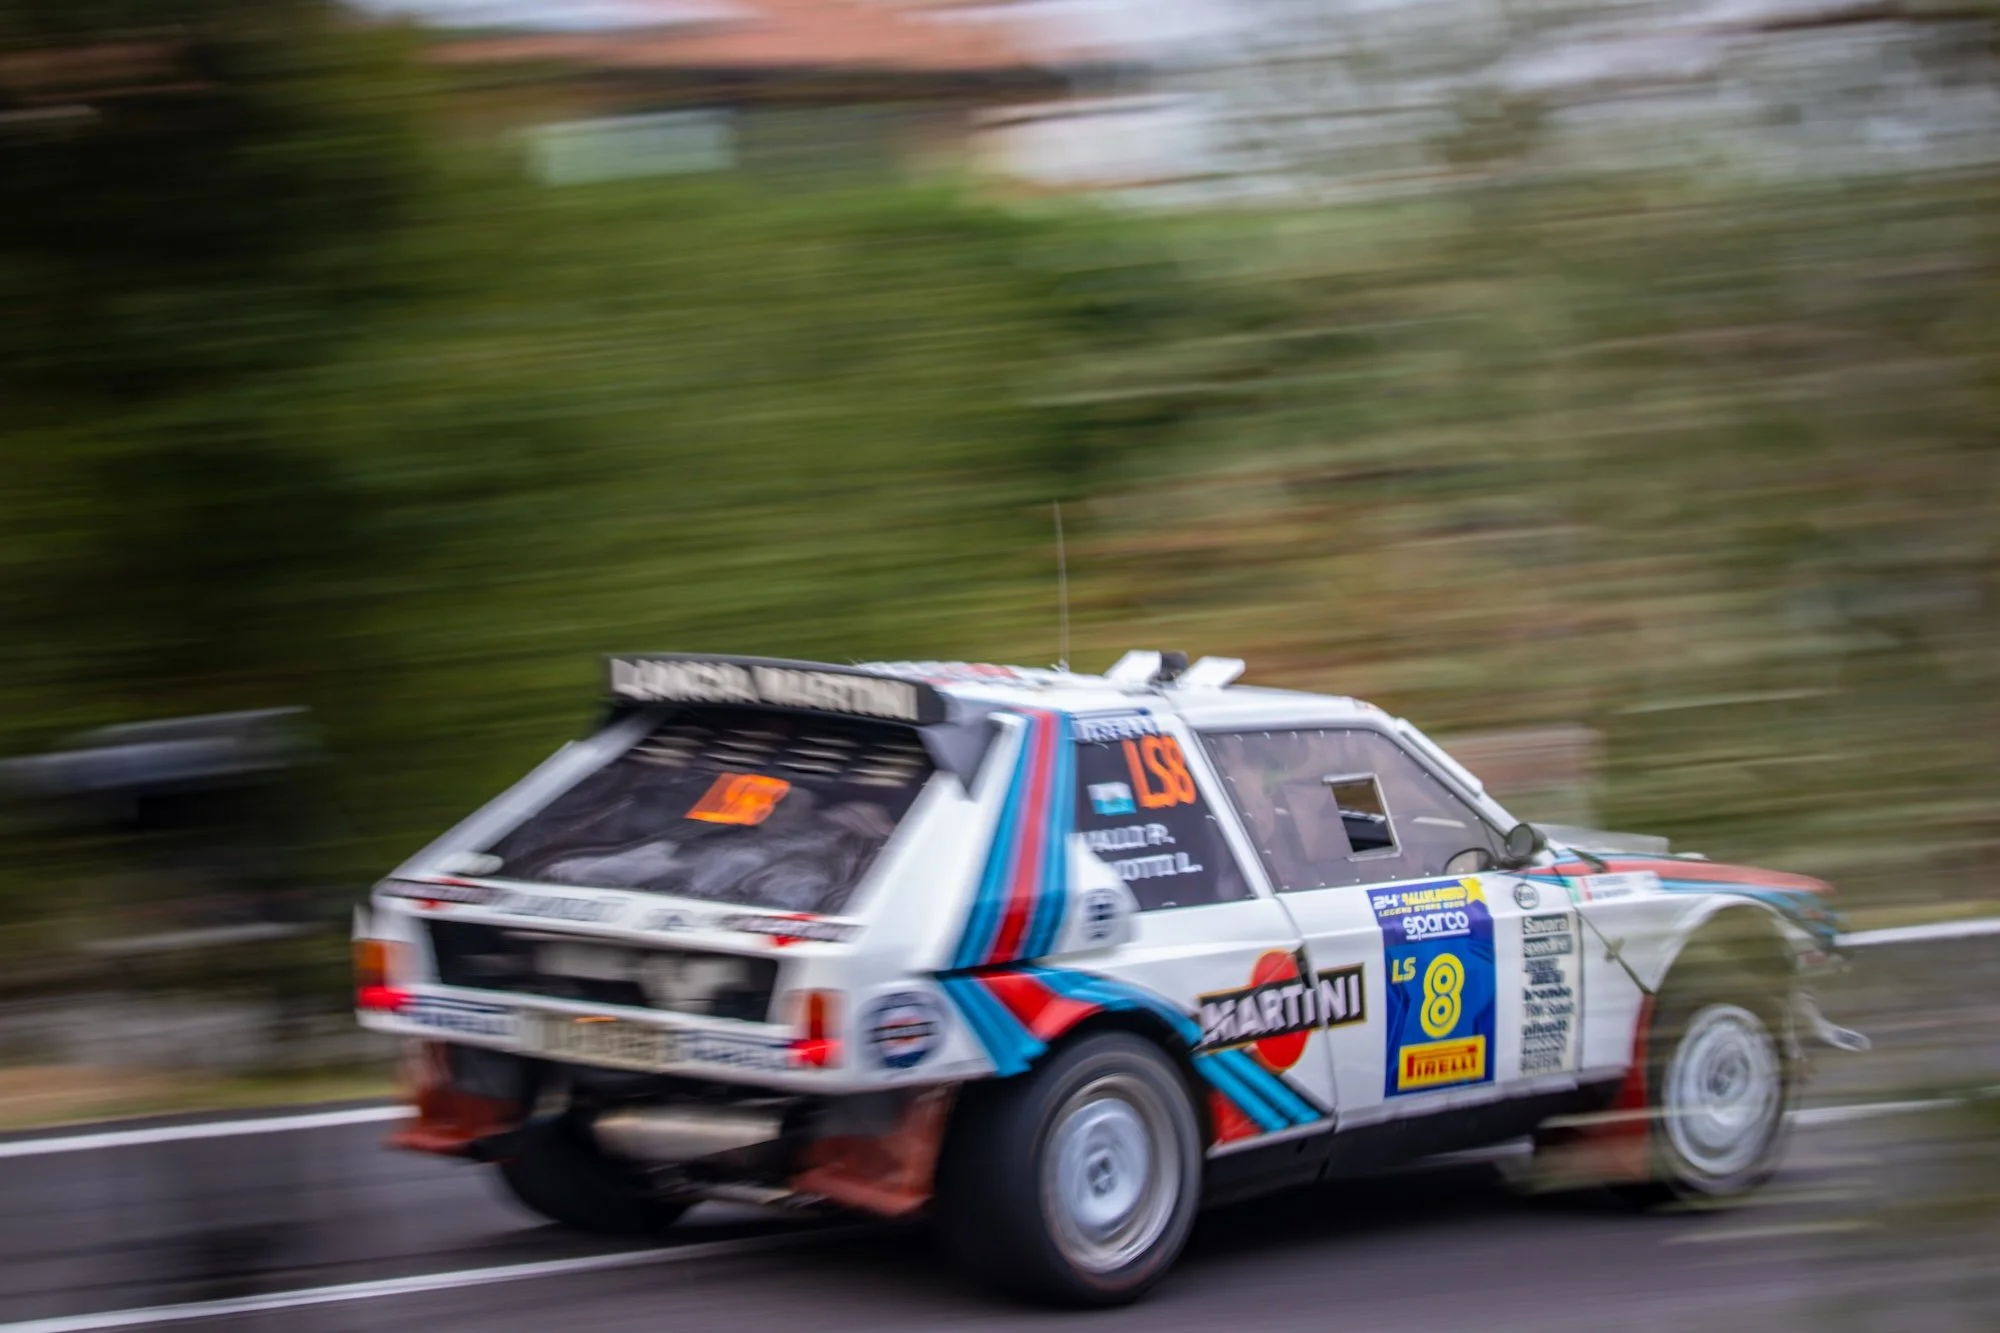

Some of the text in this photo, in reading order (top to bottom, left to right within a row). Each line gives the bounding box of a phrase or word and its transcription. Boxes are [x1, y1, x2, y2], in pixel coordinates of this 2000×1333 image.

[1121, 734, 1197, 808] LS8
[1403, 911, 1469, 940] sparco
[1392, 957, 1417, 984] LS
[1420, 953, 1465, 1038] 8
[1195, 974, 1361, 1049] MARTINI
[1406, 1045, 1478, 1080] PIRELLI
